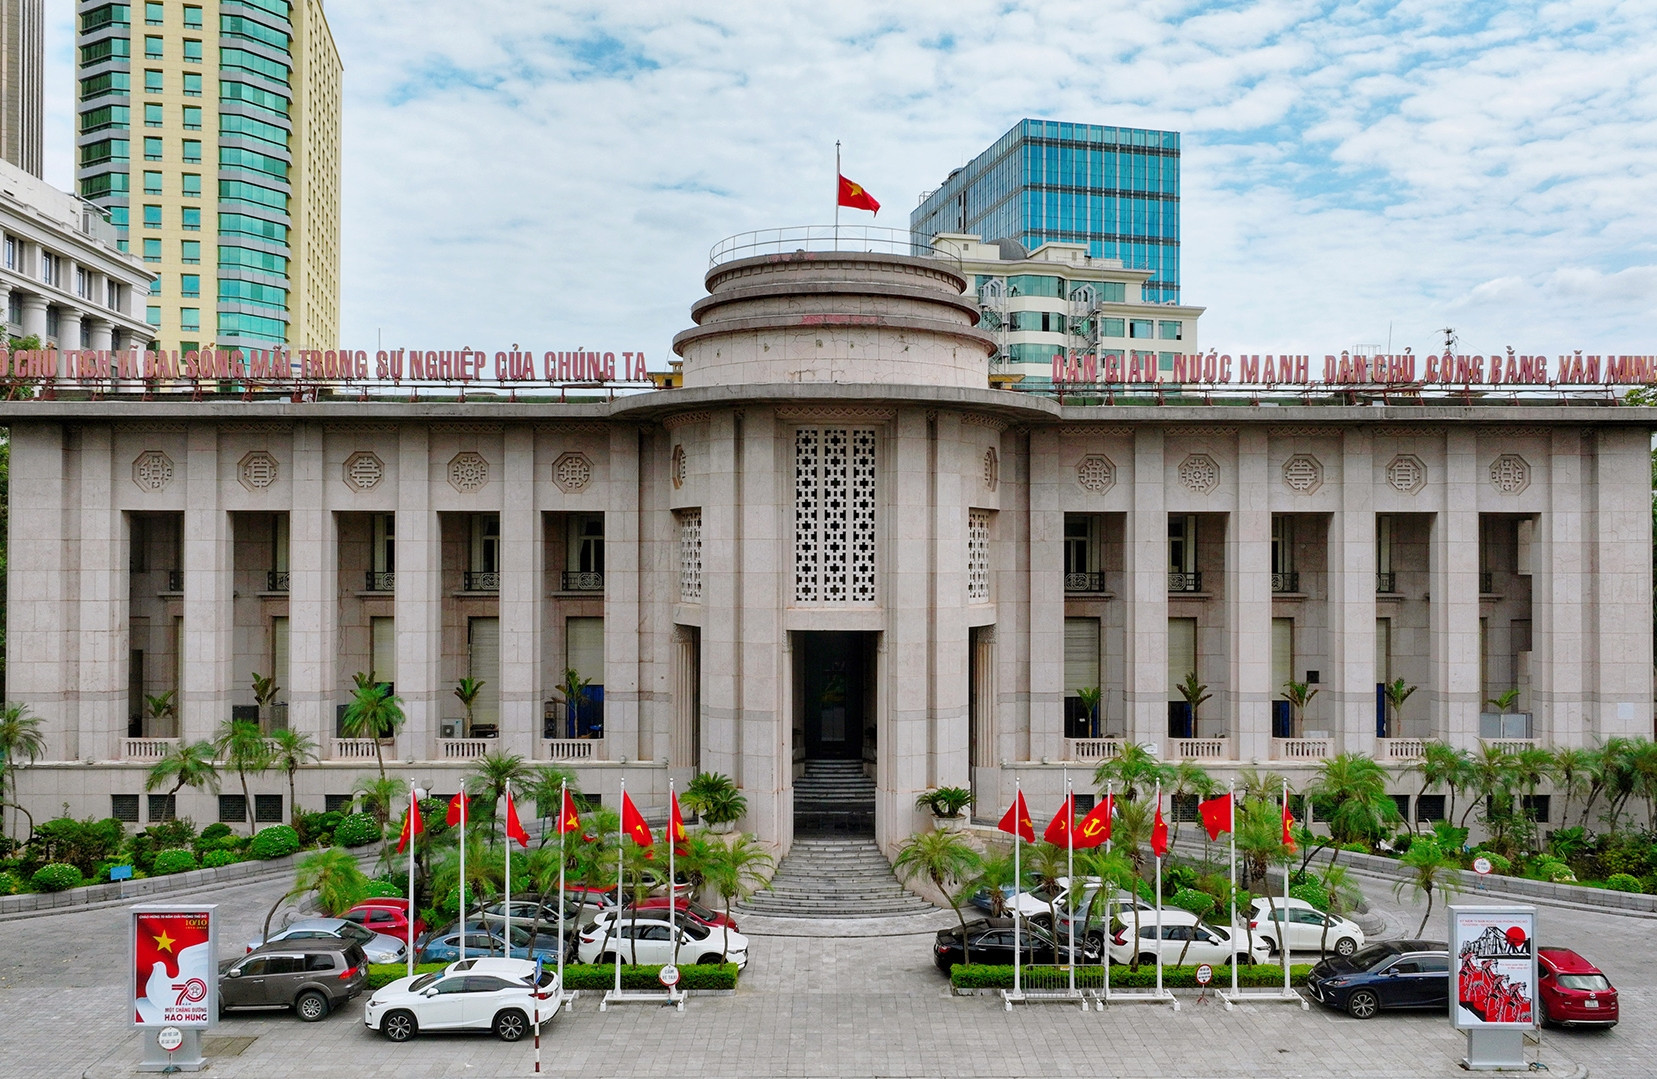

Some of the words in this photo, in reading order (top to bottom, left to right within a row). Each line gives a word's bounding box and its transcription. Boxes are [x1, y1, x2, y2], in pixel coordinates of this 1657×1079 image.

[14, 341, 57, 378] CHỦ
[63, 350, 111, 383] TỊCH
[116, 345, 138, 378] VĨ
[143, 350, 178, 383] ĐẠI
[186, 342, 244, 378] SỐNG
[250, 345, 292, 378] MÃI
[300, 350, 368, 379] TRONG
[376, 347, 404, 385] SỰ
[409, 346, 486, 385] NGHIỆP
[495, 343, 536, 380] CỦA
[544, 346, 616, 380] CHÚNG
[622, 352, 648, 380] TA
[1052, 348, 1097, 382] DÂN
[1173, 348, 1232, 383] NƯỚC
[1324, 350, 1367, 383] DÂN
[1426, 350, 1484, 383] CÔNG
[1559, 350, 1600, 383] VĂN
[1607, 355, 1657, 383] MINH
[171, 978, 207, 1006] 70
